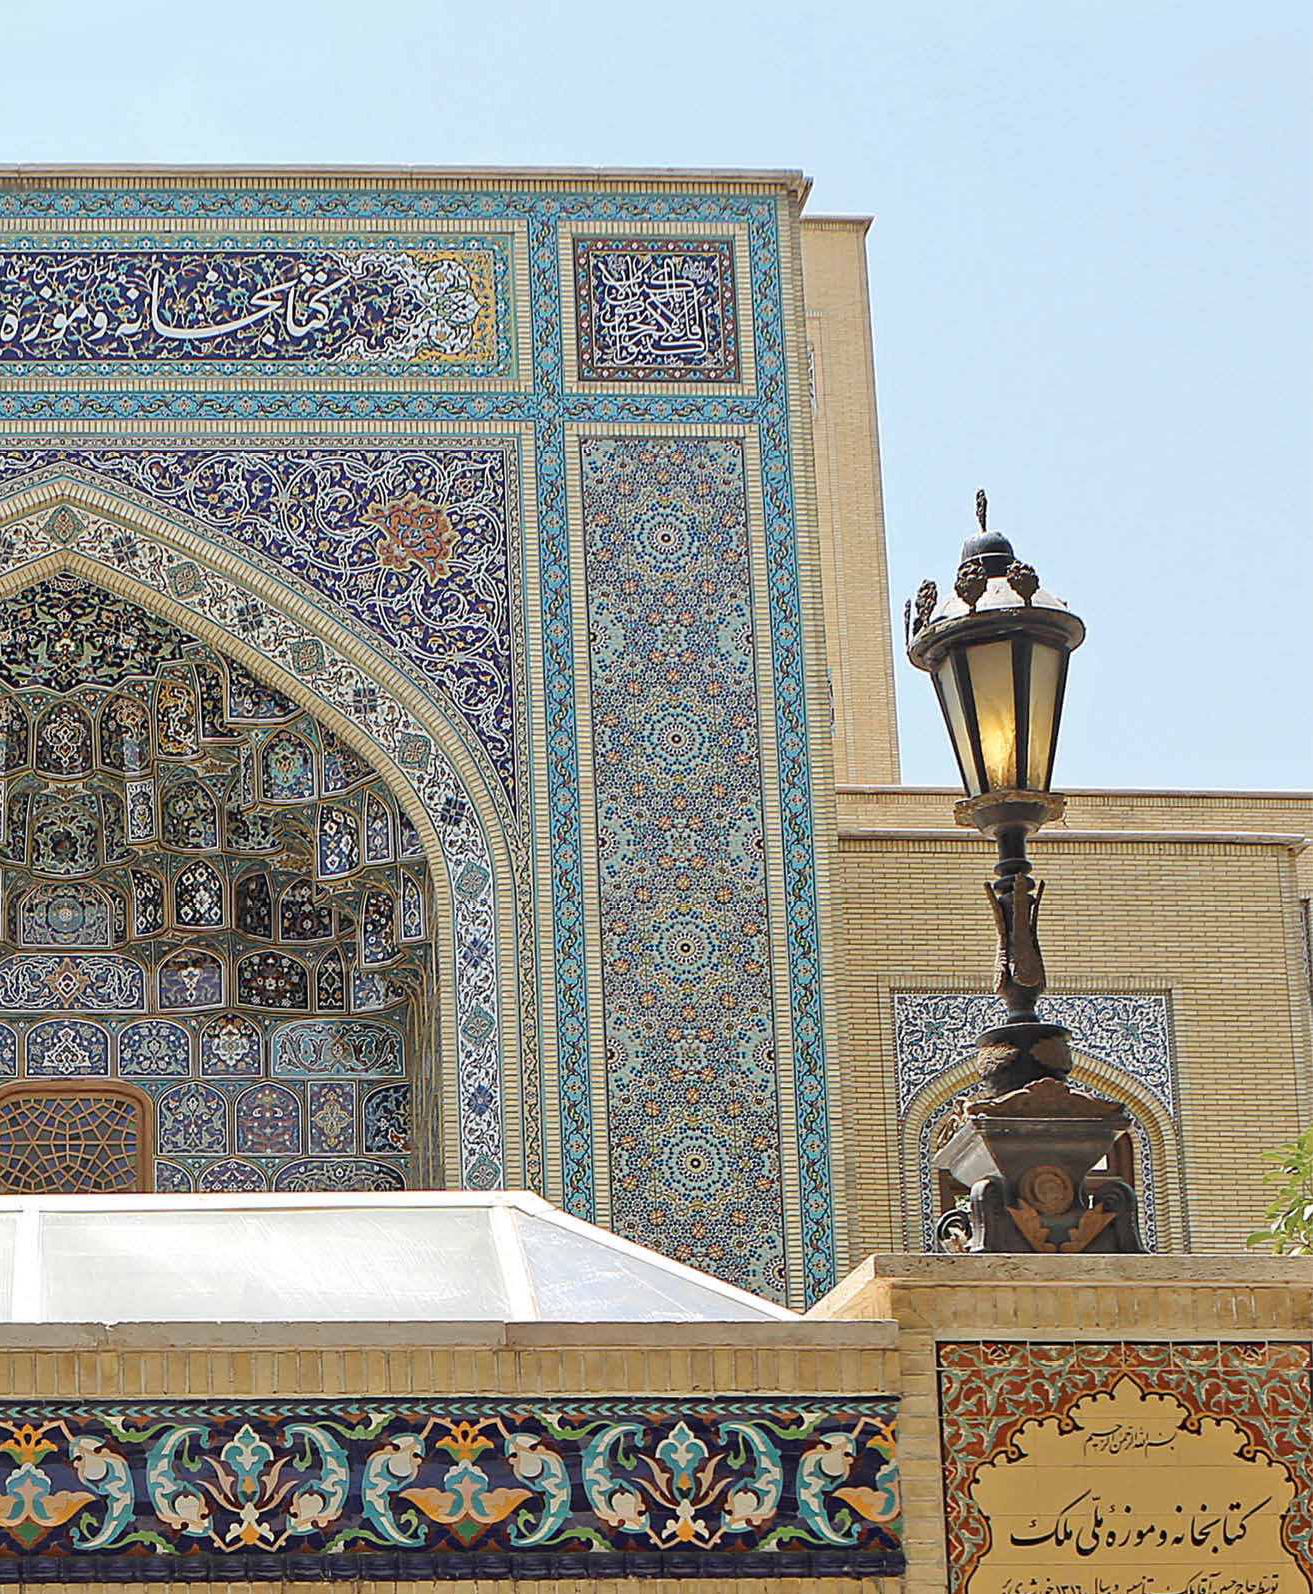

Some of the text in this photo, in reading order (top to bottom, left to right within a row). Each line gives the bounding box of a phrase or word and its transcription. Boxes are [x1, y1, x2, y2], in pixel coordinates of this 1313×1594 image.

[115, 267, 354, 344] کتابخانه
[1155, 1527, 1168, 1547] و
[1170, 1495, 1273, 1554] کتابخانه
